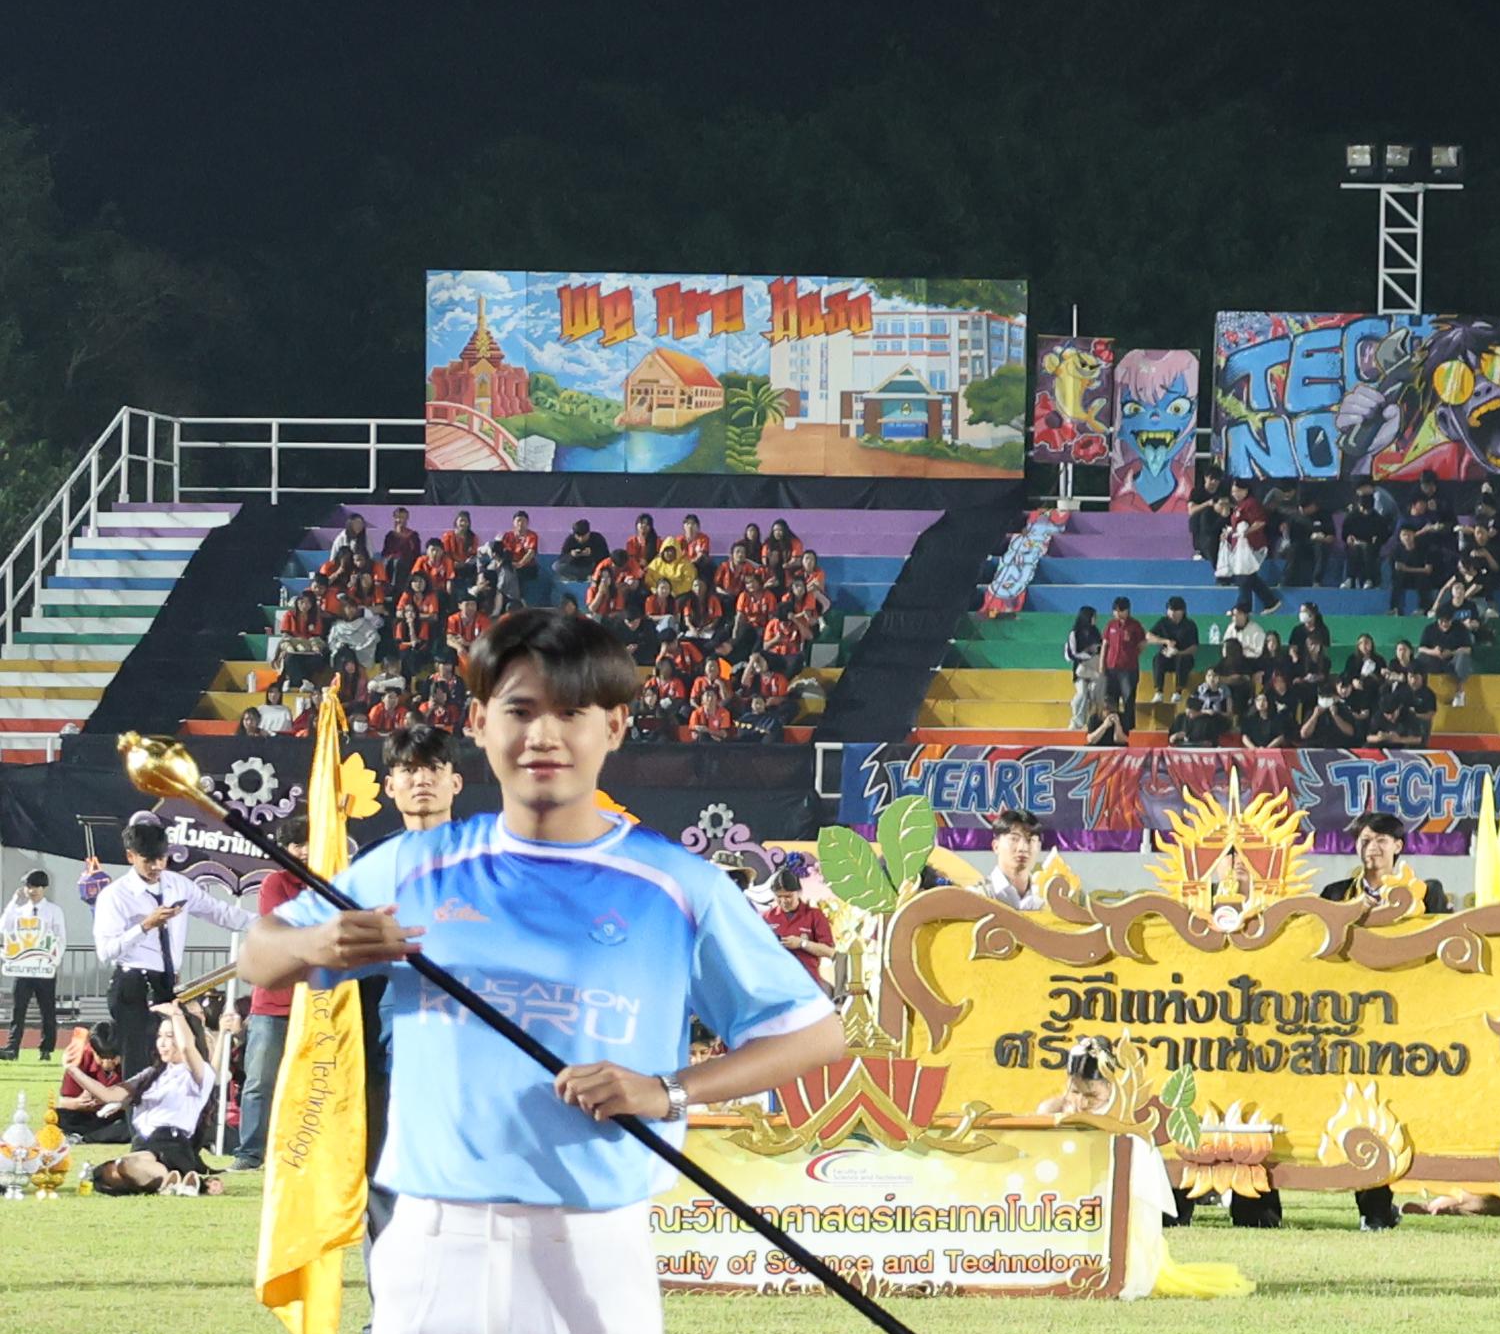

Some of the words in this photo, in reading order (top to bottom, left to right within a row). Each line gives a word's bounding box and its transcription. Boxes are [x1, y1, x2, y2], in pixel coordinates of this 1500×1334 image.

[556, 281, 637, 347] We
[653, 281, 745, 340] Are
[282, 1056, 337, 1169] Technology
[728, 1250, 756, 1274] of
[883, 1250, 934, 1274] and
